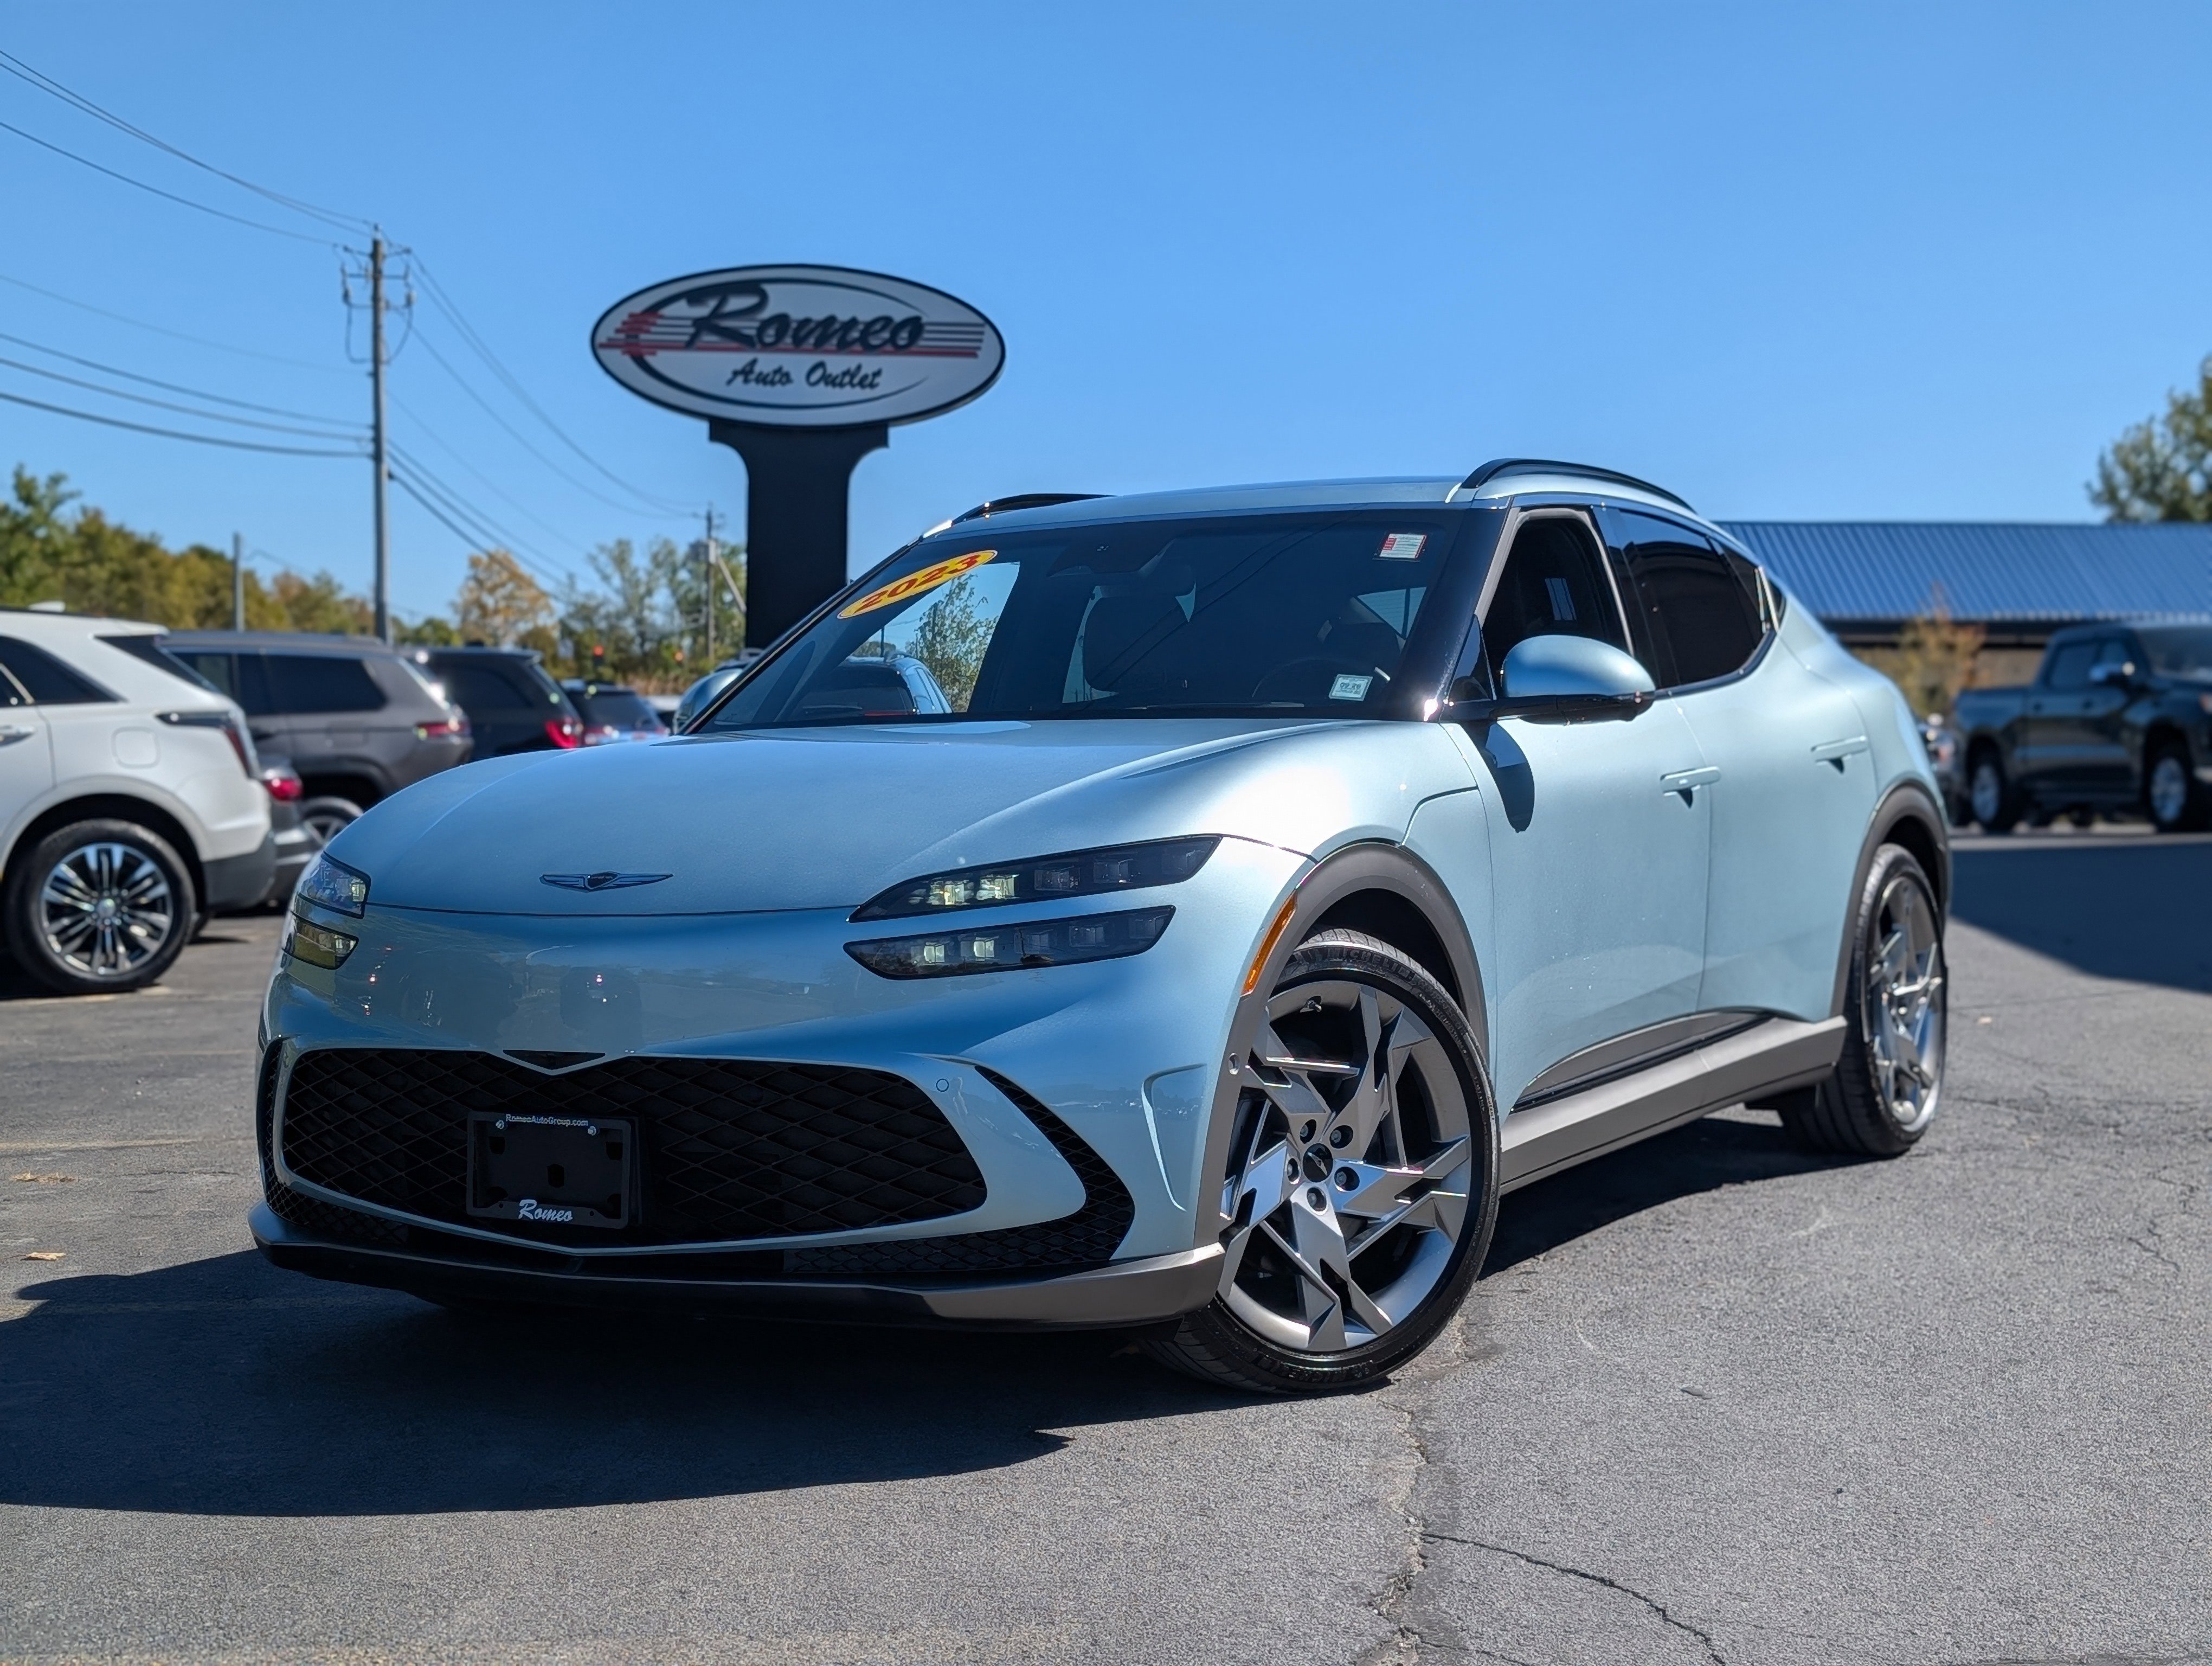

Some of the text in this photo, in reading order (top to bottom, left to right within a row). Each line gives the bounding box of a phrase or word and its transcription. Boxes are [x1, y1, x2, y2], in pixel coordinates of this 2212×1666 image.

[684, 281, 925, 351] Romeo
[726, 358, 881, 389] Auto Outlet
[852, 554, 981, 615] 2023
[1328, 947, 1412, 979] MICHELIN
[518, 1199, 573, 1222] Romeo
